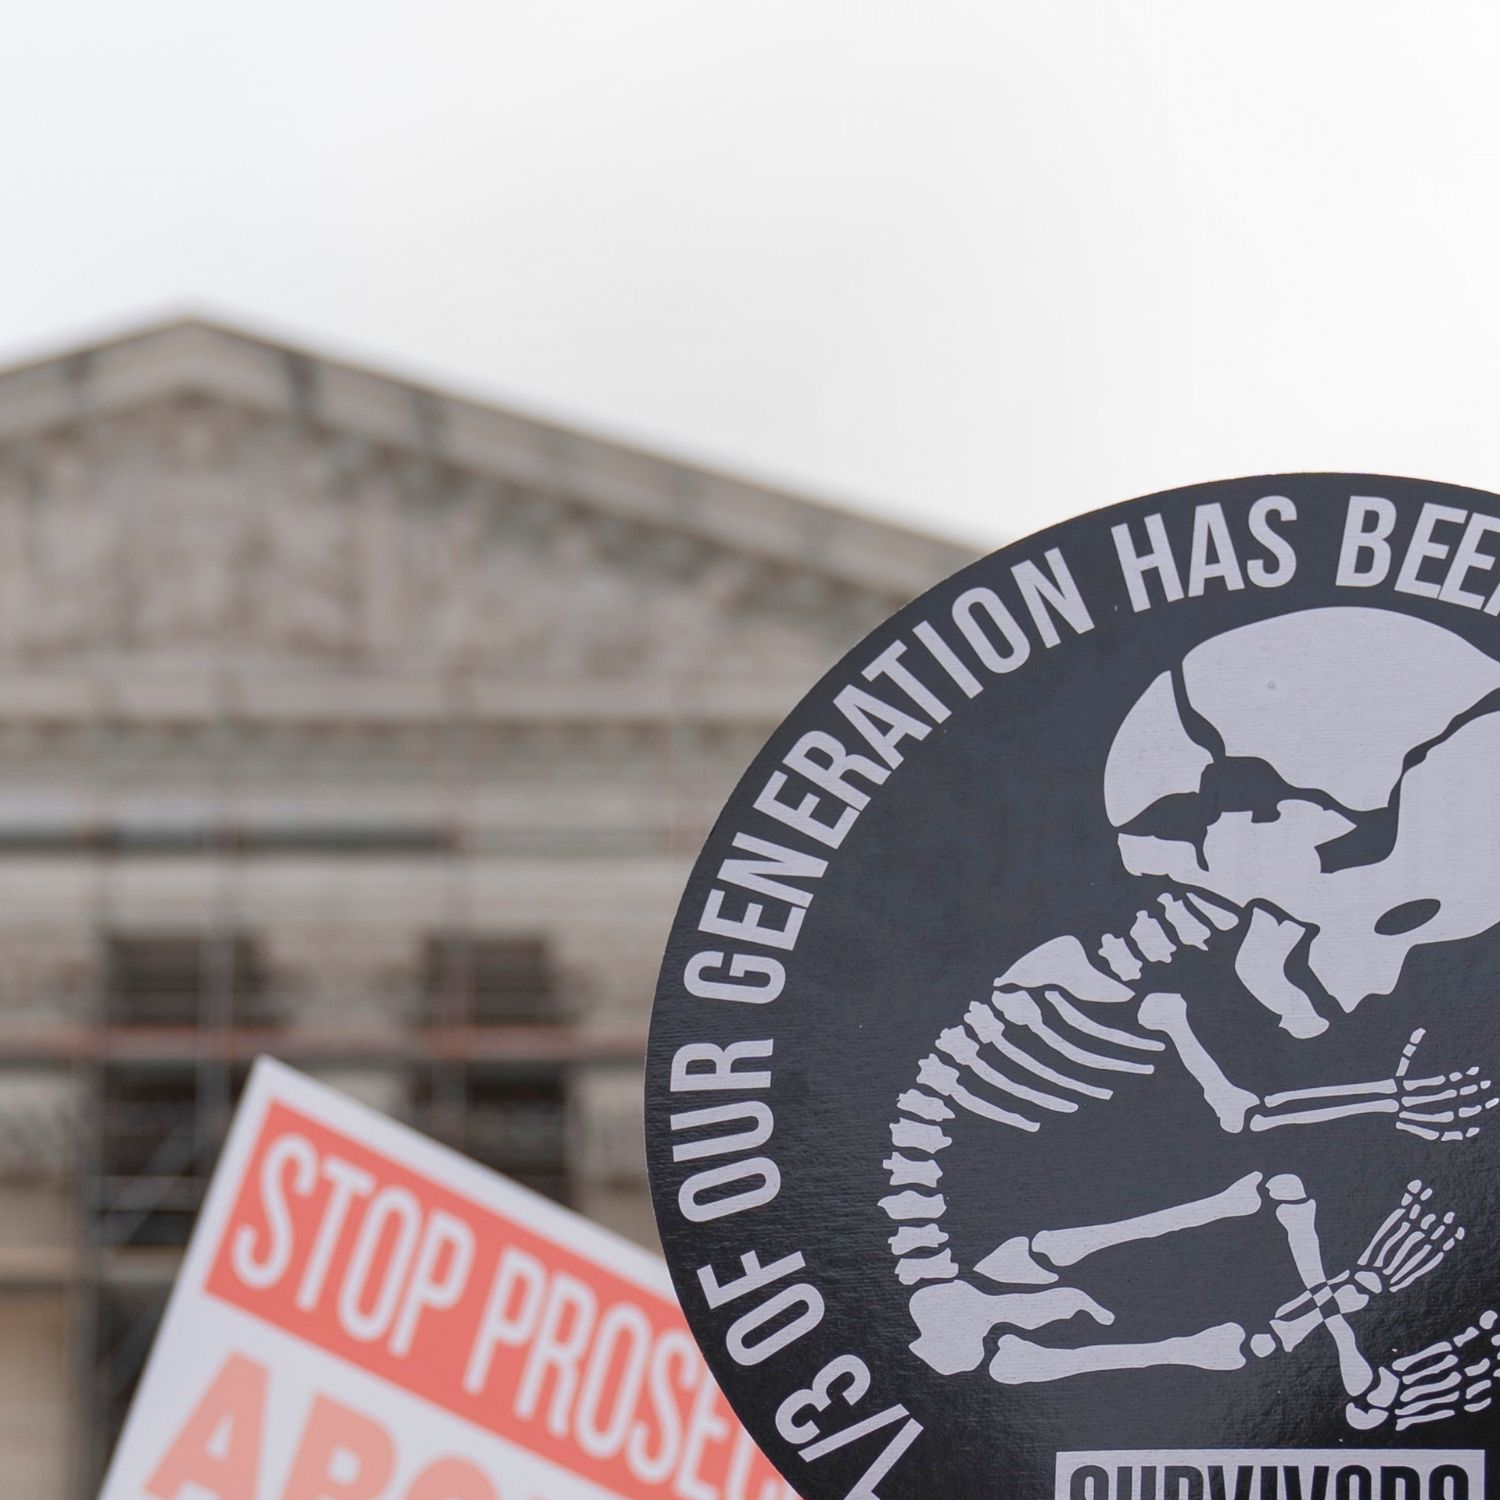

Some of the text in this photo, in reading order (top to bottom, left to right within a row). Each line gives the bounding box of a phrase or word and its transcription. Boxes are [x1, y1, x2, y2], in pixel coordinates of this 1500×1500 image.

[1111, 495, 1297, 612] HAS
[684, 547, 1095, 1004] GENERATION
[669, 1038, 781, 1222] OUR
[231, 1132, 475, 1359] STOP
[696, 1250, 826, 1366] OF
